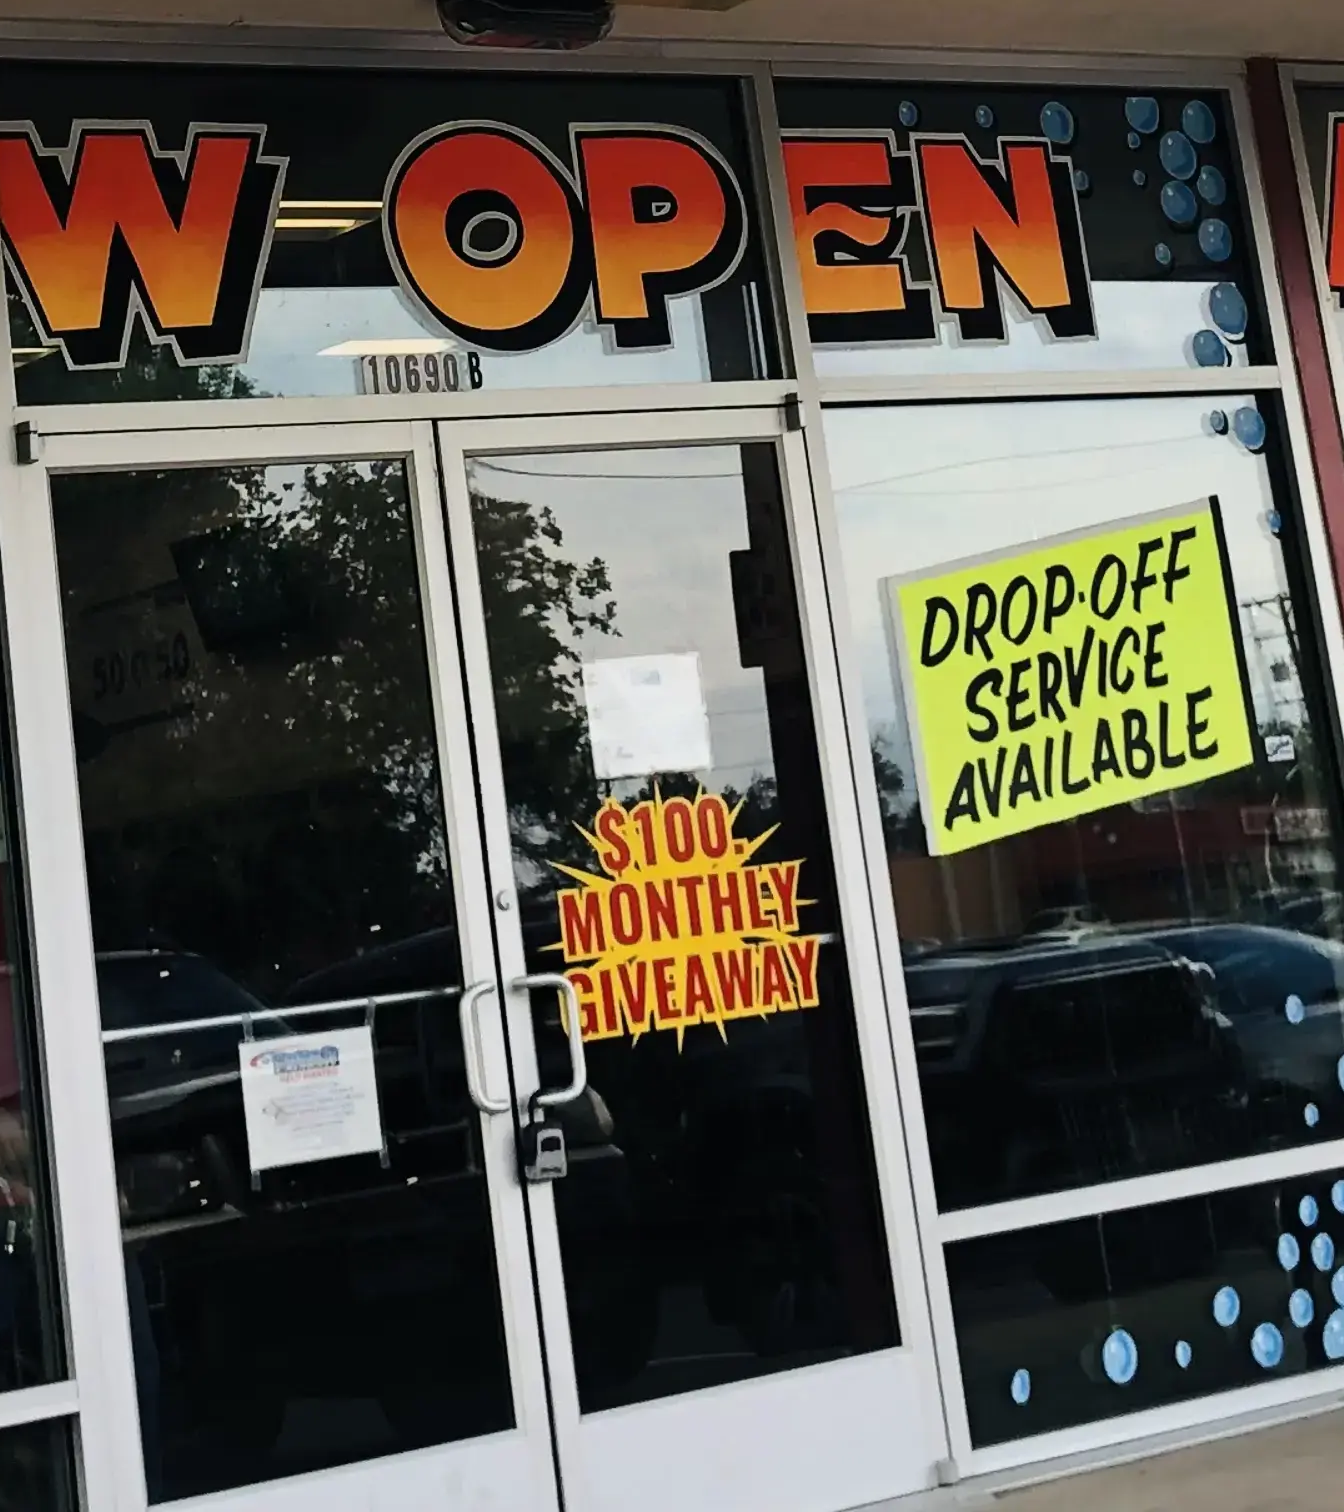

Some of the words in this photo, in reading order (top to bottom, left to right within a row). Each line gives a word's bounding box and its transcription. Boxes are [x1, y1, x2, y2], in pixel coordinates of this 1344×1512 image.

[382, 118, 1099, 352] OPEN
[368, 353, 459, 395] 10690
[467, 351, 484, 390] B
[964, 622, 1169, 743] SERVICE
[944, 686, 1219, 832] AVAILABLE
[561, 864, 797, 956] MONTHLY
[567, 939, 817, 1036] GIVEAWAY
